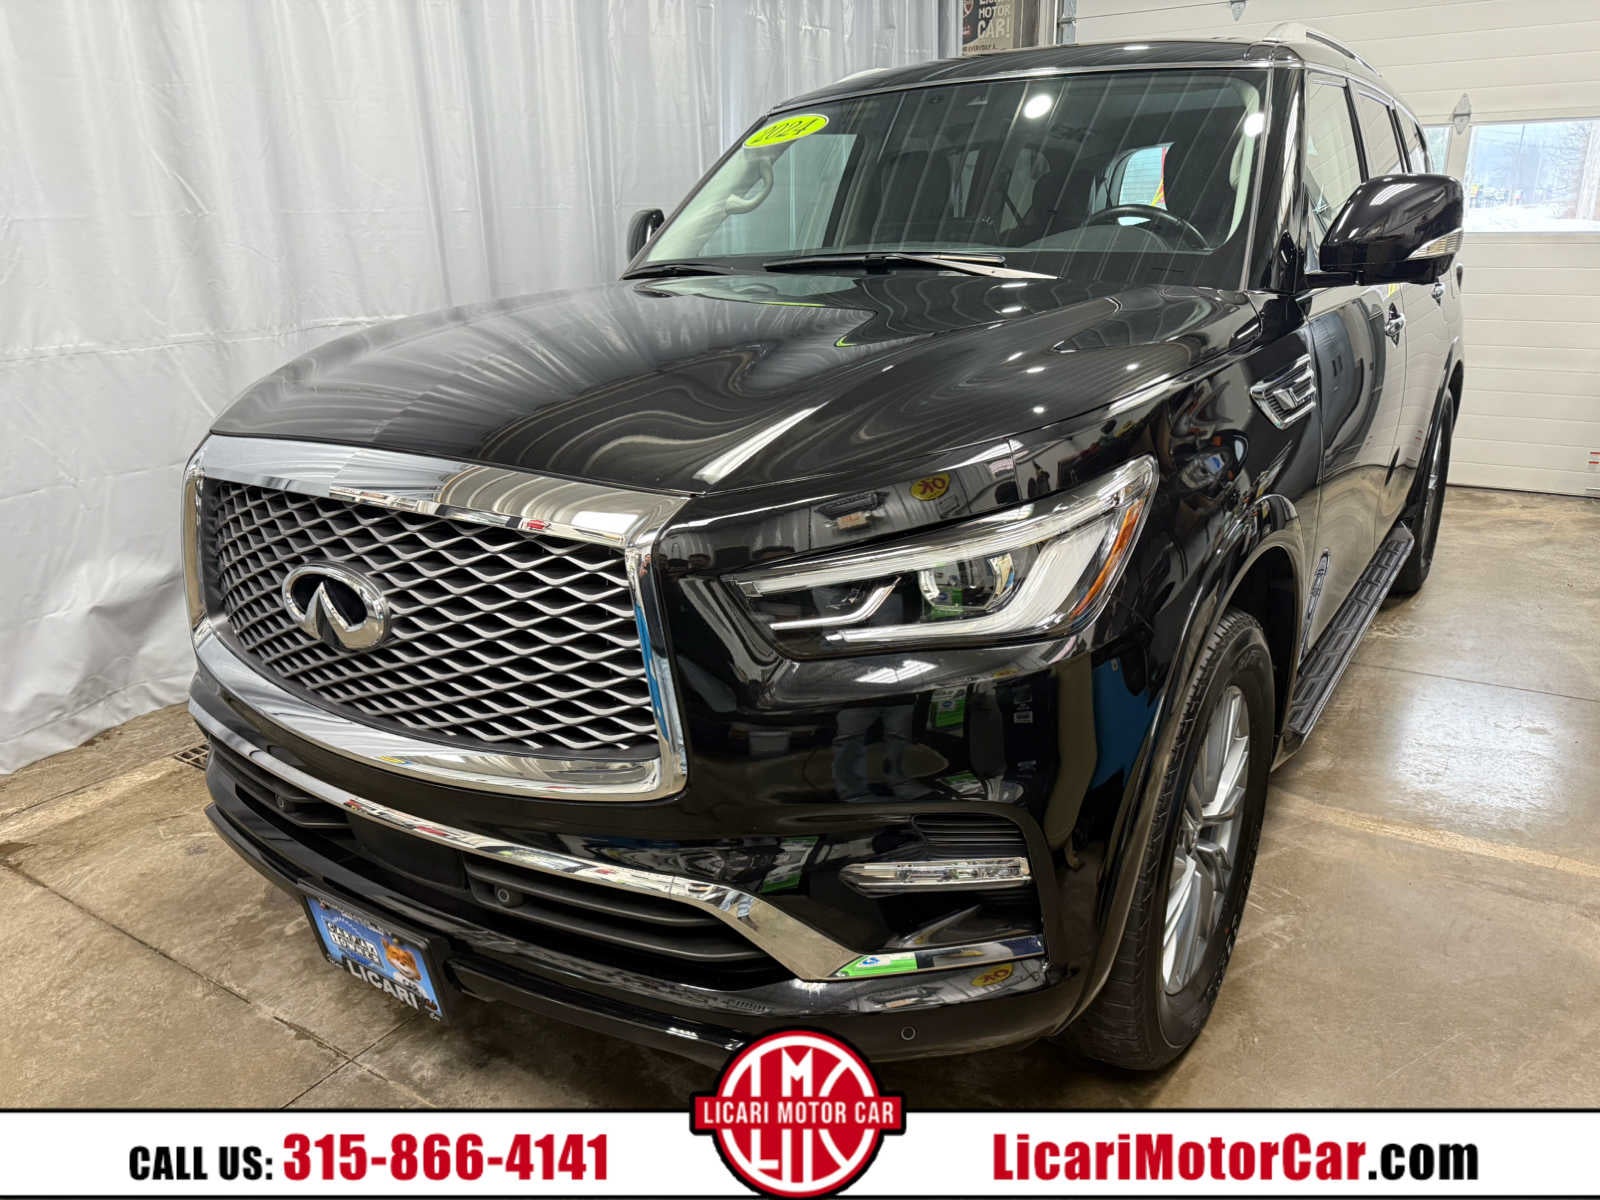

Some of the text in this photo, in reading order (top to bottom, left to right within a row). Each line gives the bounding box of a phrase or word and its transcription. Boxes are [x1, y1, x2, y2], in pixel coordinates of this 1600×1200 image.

[978, 5, 1010, 19] MOTOR
[977, 16, 1010, 38] CAR!
[346, 958, 419, 1010] LICARI
